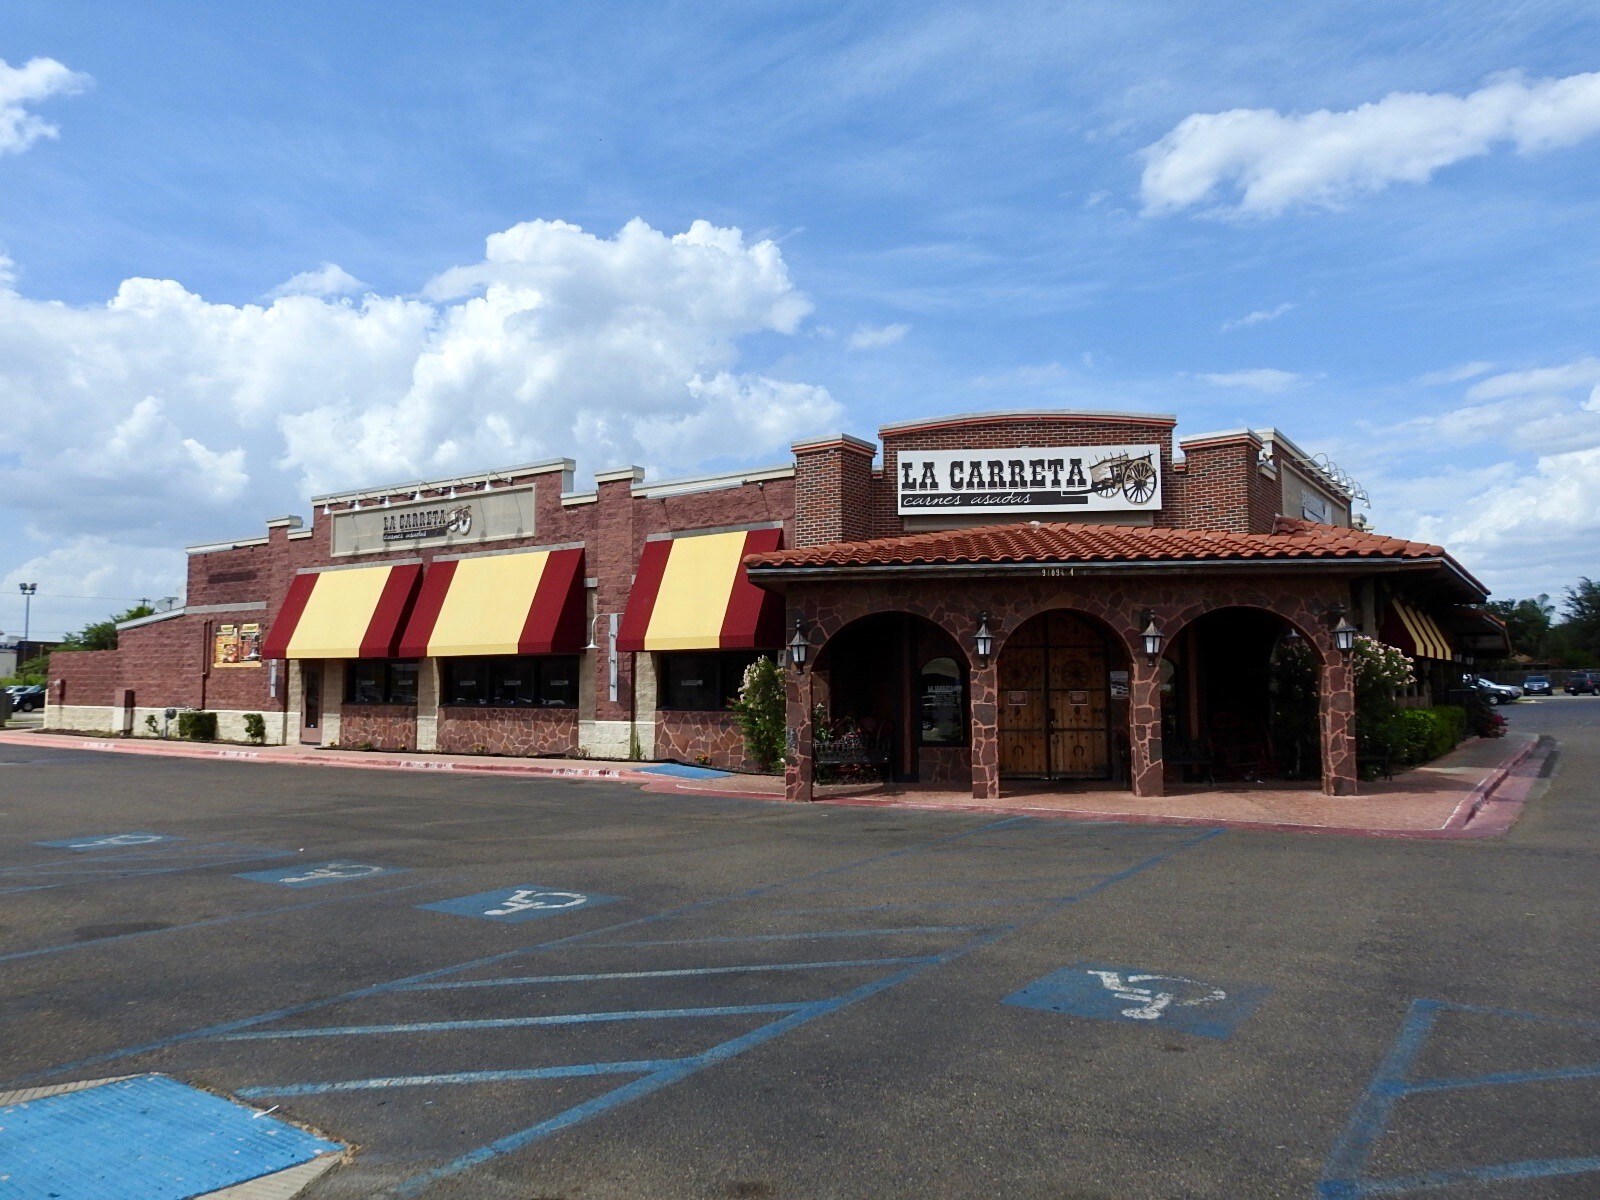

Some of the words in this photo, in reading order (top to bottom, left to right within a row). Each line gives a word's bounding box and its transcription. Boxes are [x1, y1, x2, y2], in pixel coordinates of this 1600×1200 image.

[901, 461, 939, 491] LA
[949, 458, 1087, 491] CARRETA
[903, 494, 962, 507] carnes
[970, 491, 1032, 505] asadas
[383, 516, 396, 531] LA
[399, 509, 446, 530] CARRETA
